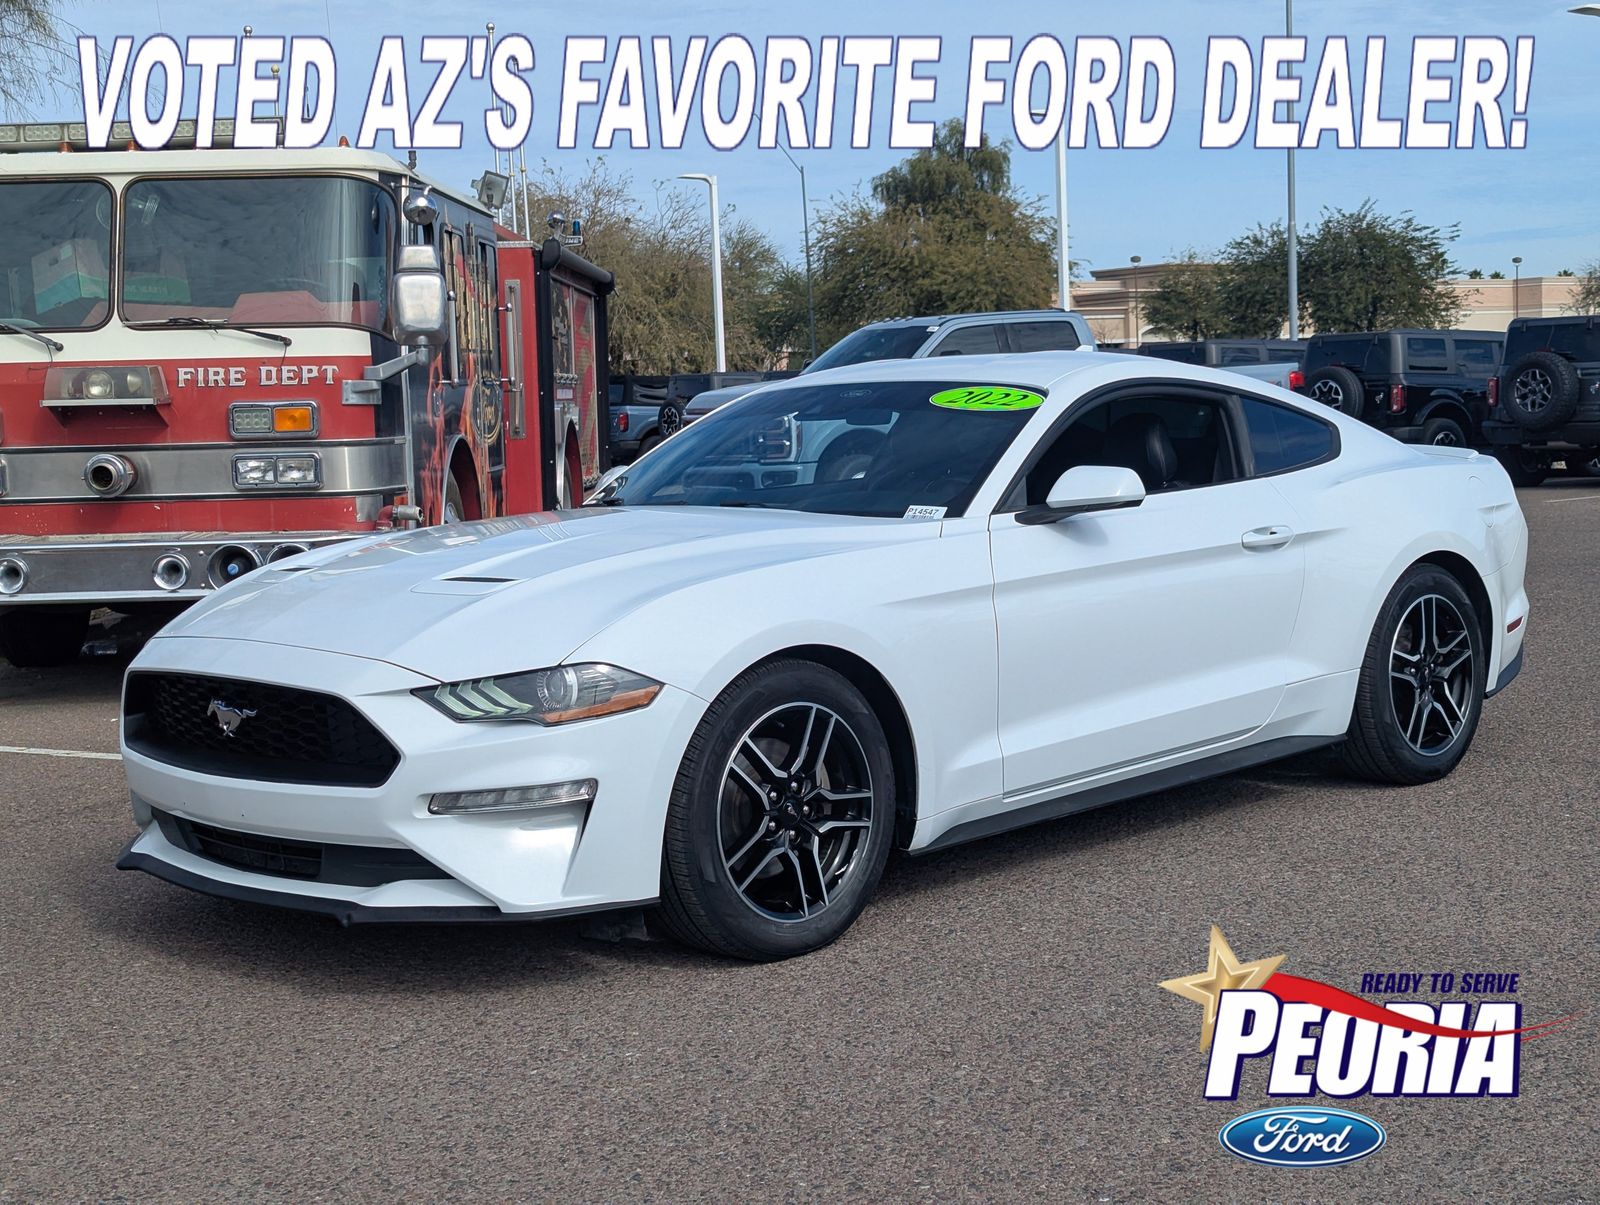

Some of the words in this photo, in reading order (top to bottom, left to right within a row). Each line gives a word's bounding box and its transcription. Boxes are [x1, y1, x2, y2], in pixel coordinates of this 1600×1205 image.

[177, 366, 247, 388] FIRE
[259, 364, 340, 387] DEPT
[944, 391, 1029, 406] 2022
